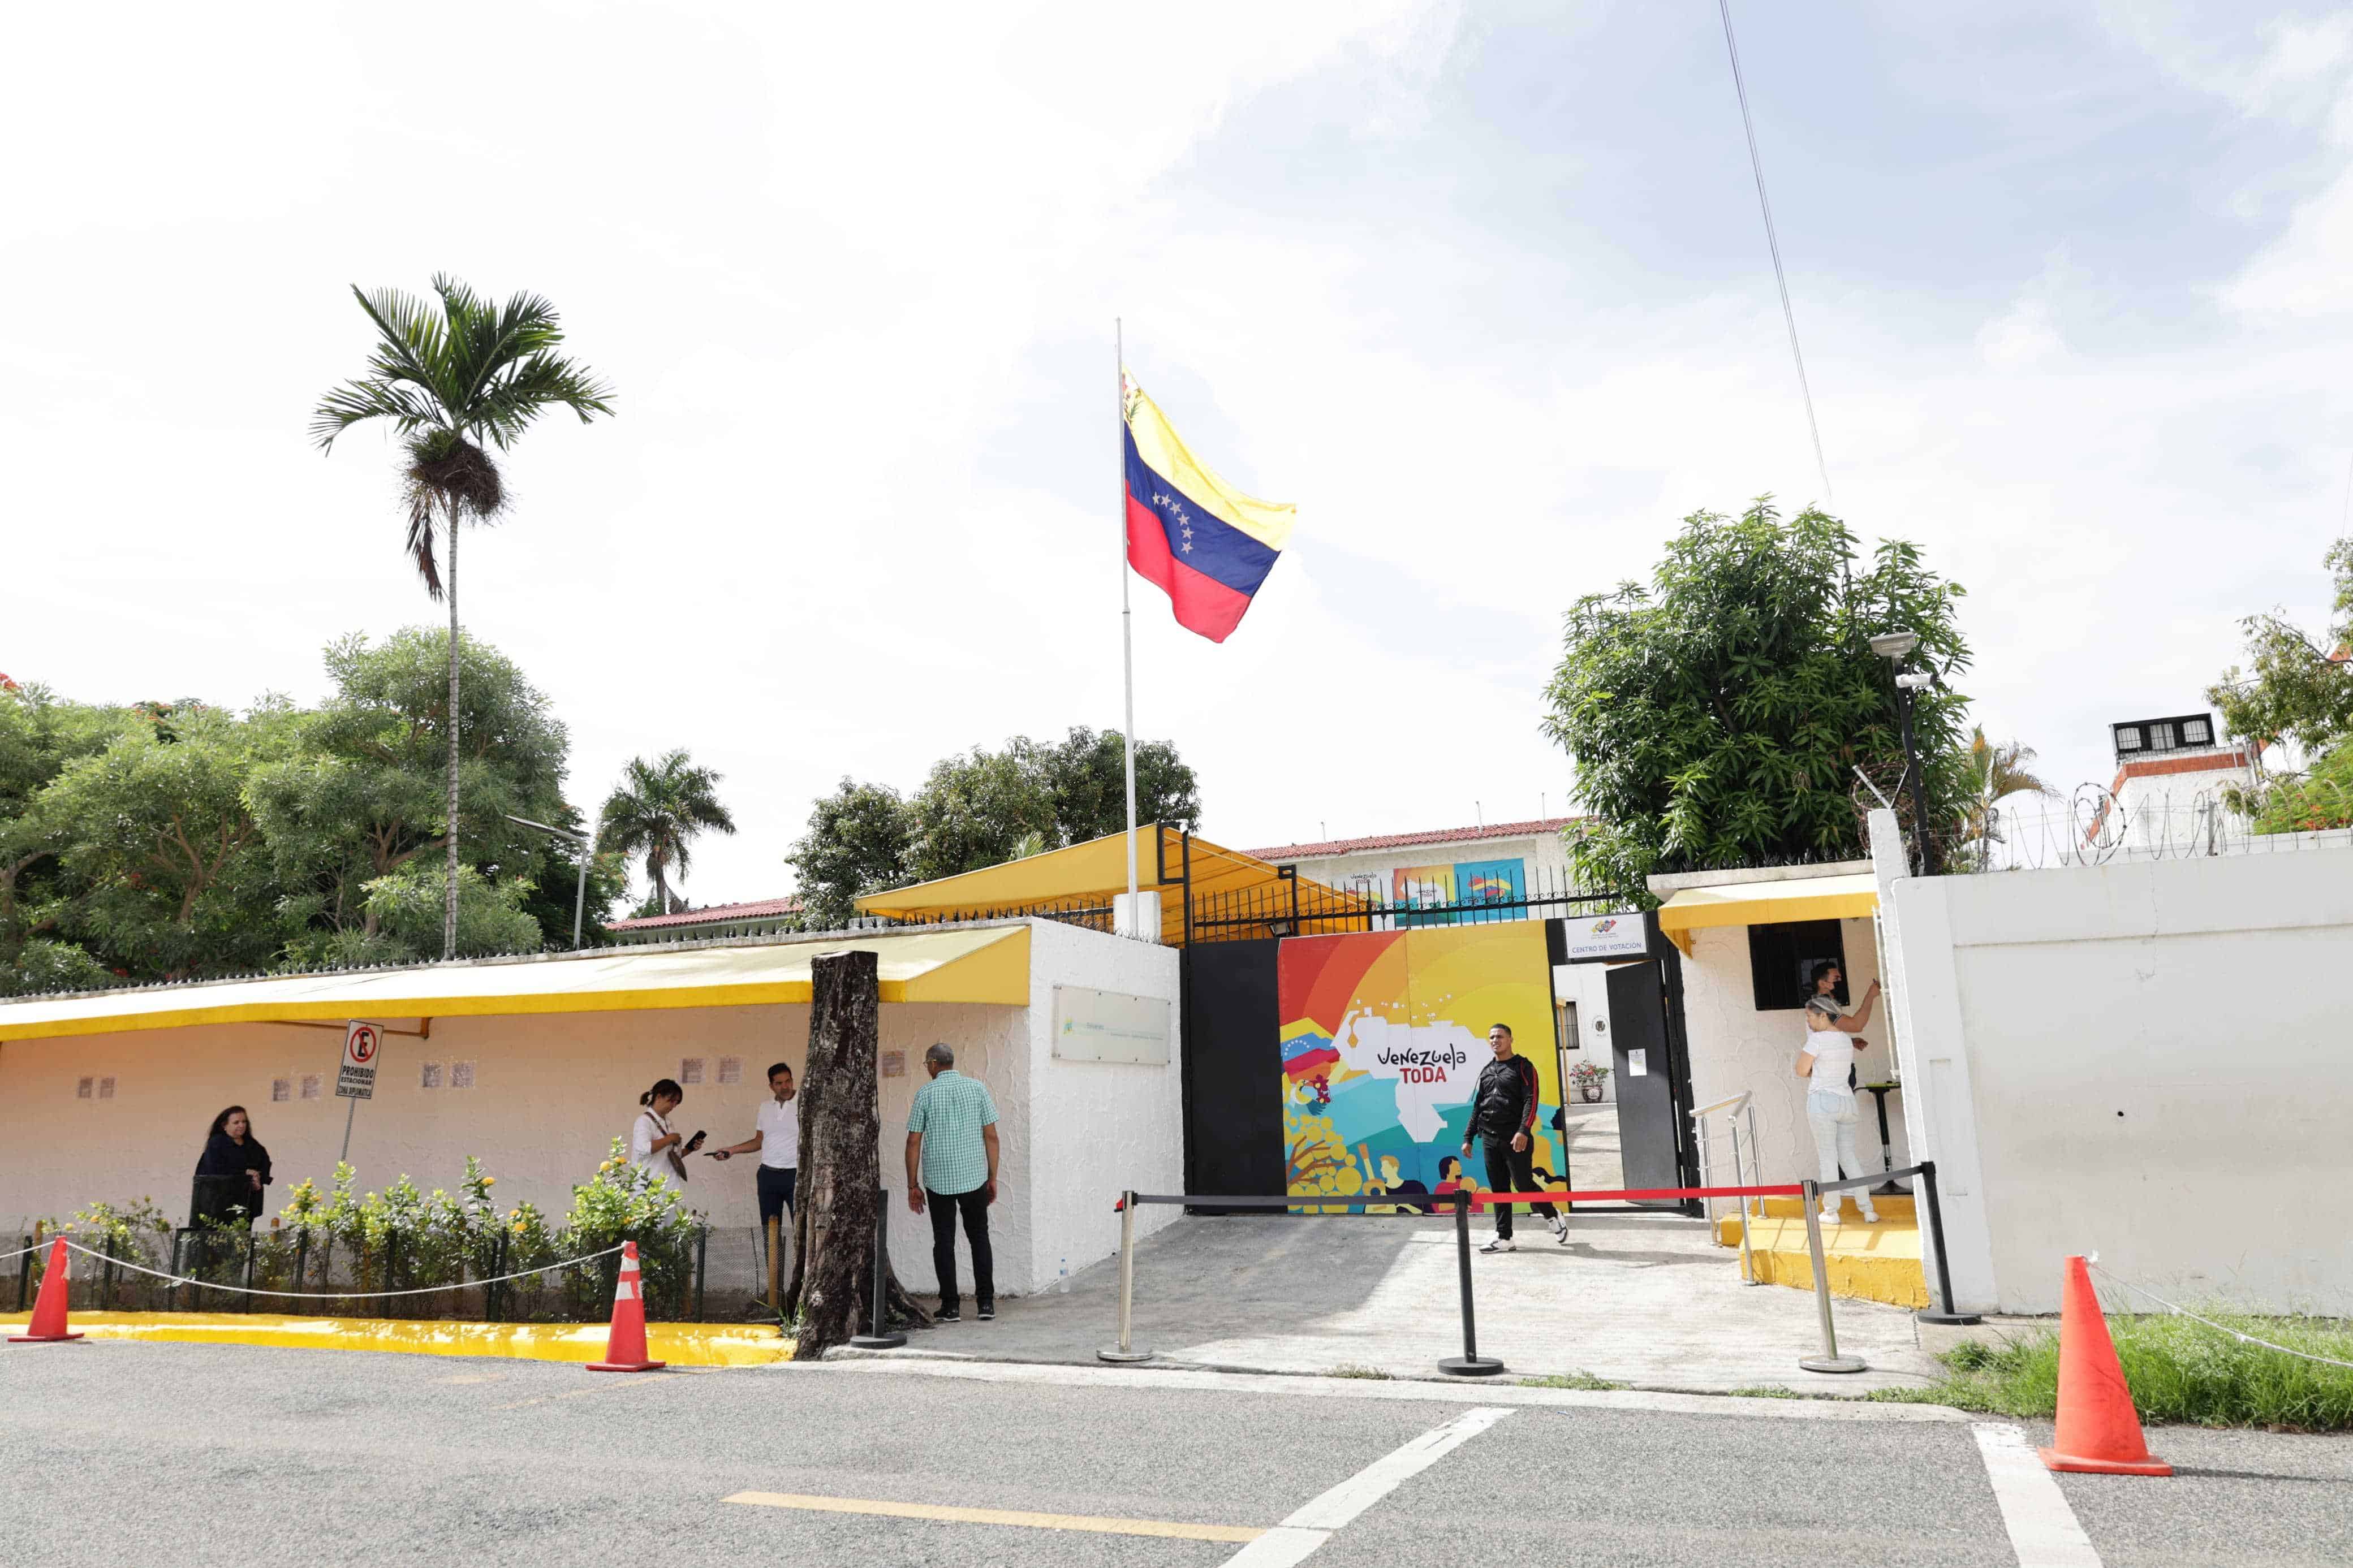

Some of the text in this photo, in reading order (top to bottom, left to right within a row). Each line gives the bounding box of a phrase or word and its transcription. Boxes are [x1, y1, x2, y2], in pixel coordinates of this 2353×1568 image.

[1610, 941, 1642, 950] VOTACIÓN
[342, 1065, 374, 1078] PROHIBIDO
[1399, 1066, 1447, 1084] TODA
[341, 1077, 372, 1085] ESTACIONAR
[338, 1085, 348, 1094] ZONA
